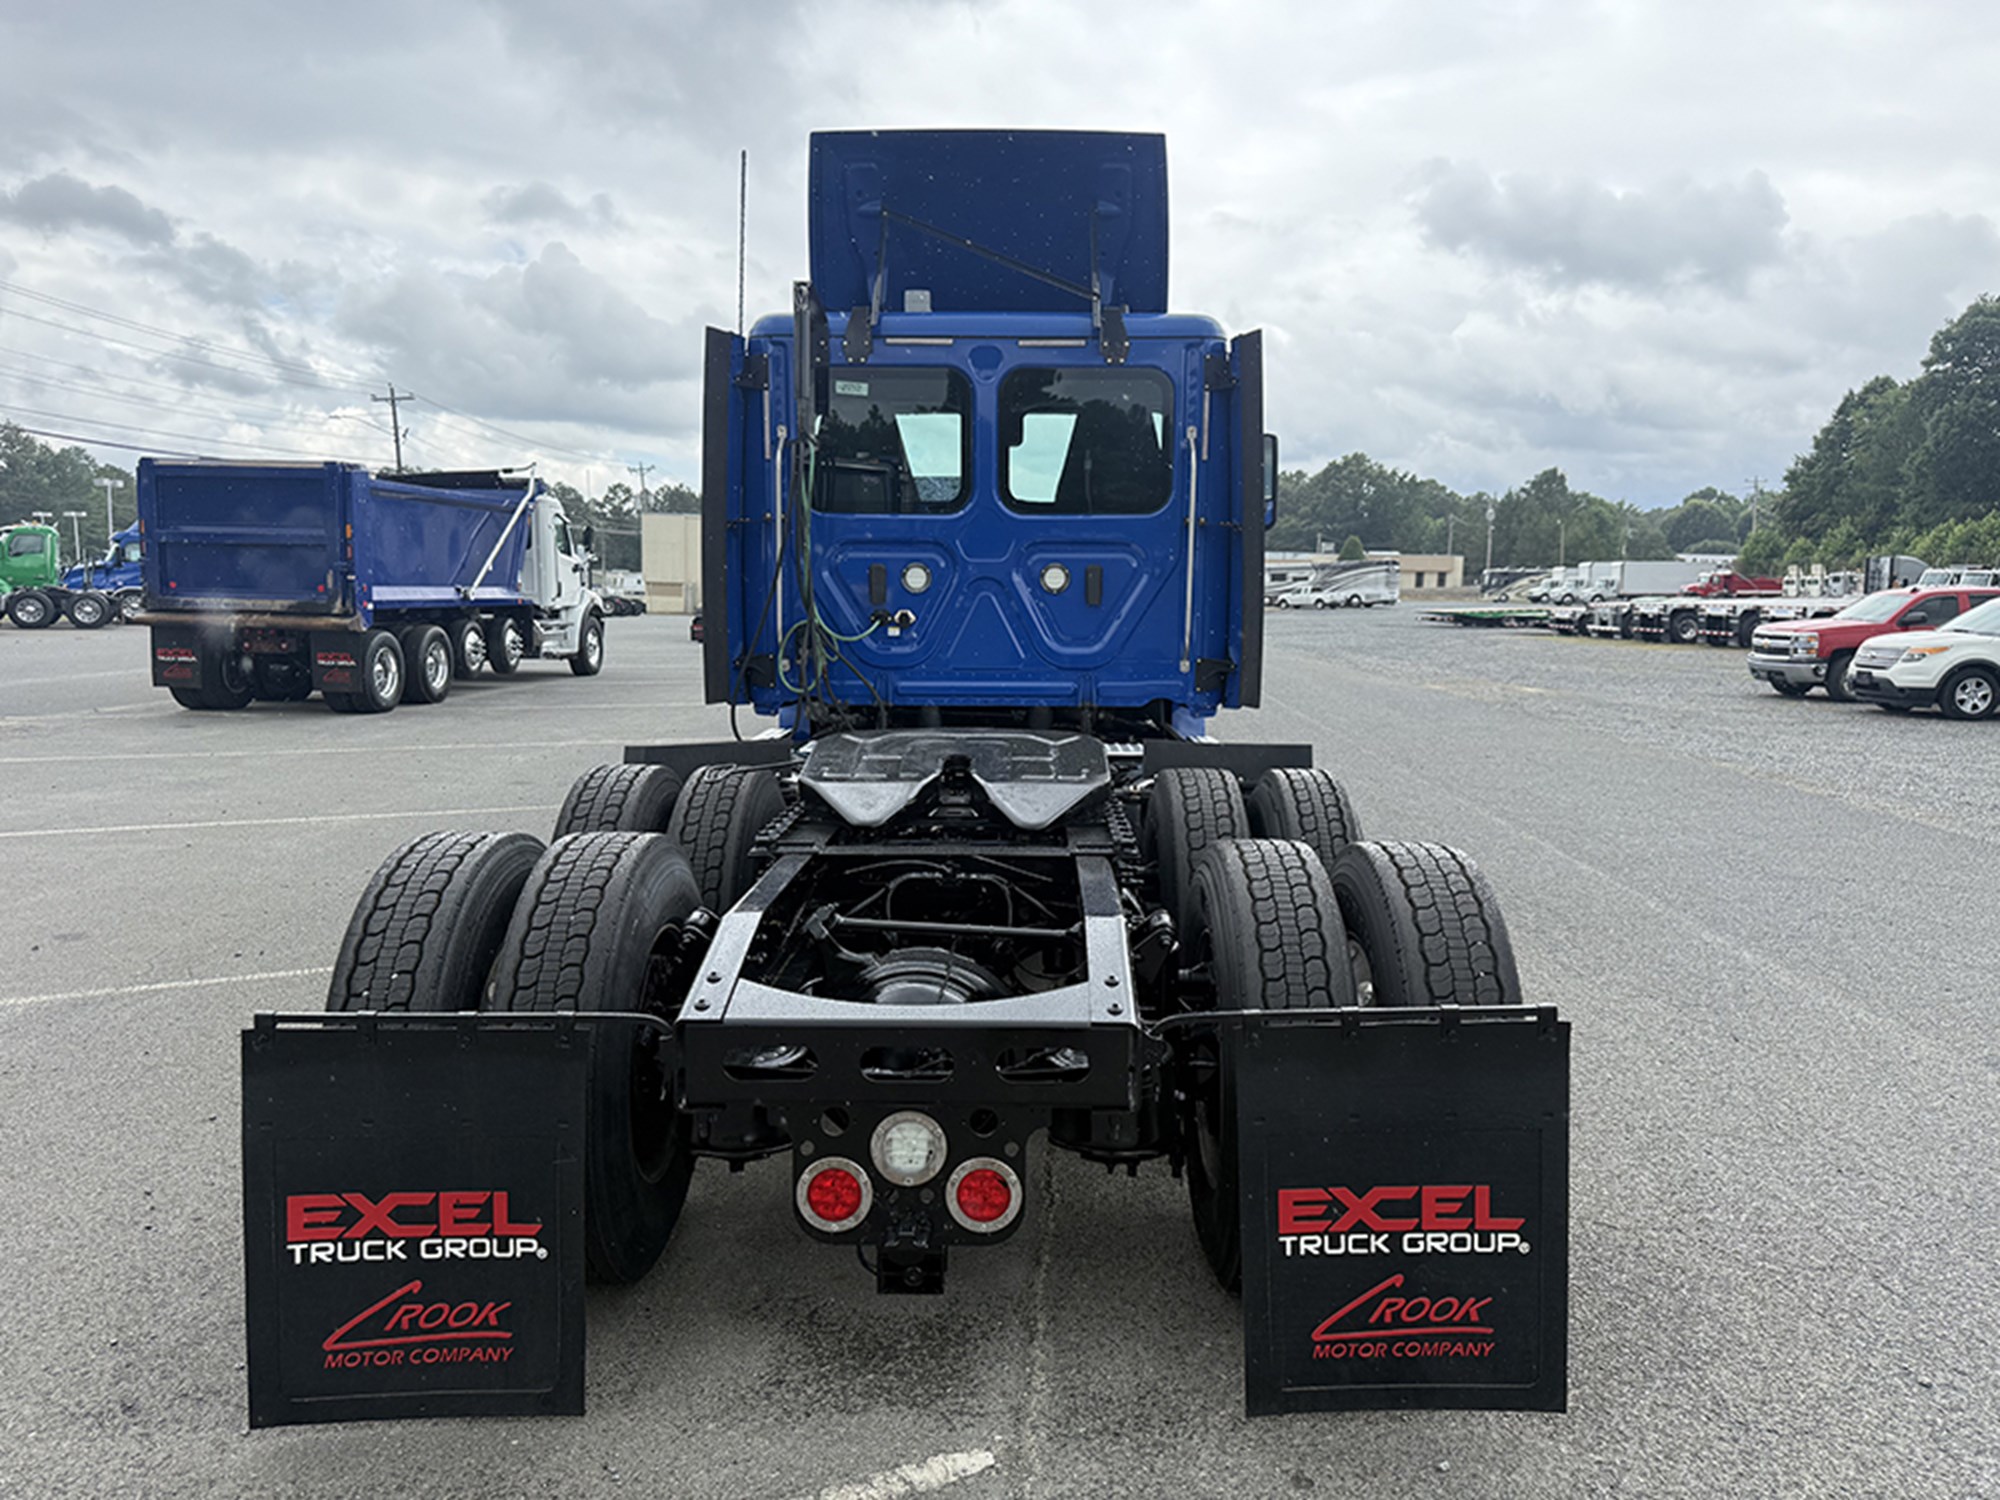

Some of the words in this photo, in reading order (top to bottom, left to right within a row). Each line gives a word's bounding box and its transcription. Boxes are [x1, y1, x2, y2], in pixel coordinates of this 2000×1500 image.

[286, 1191, 543, 1242] EXCEL
[1277, 1185, 1526, 1235] EXCEL
[286, 1239, 407, 1265] TRUCK
[1278, 1233, 1391, 1257] TRUCK
[324, 1349, 404, 1369] MOTOR
[409, 1346, 514, 1364] COMPANY
[1312, 1342, 1387, 1360] MOTOR
[1391, 1341, 1496, 1358] COMPANY
